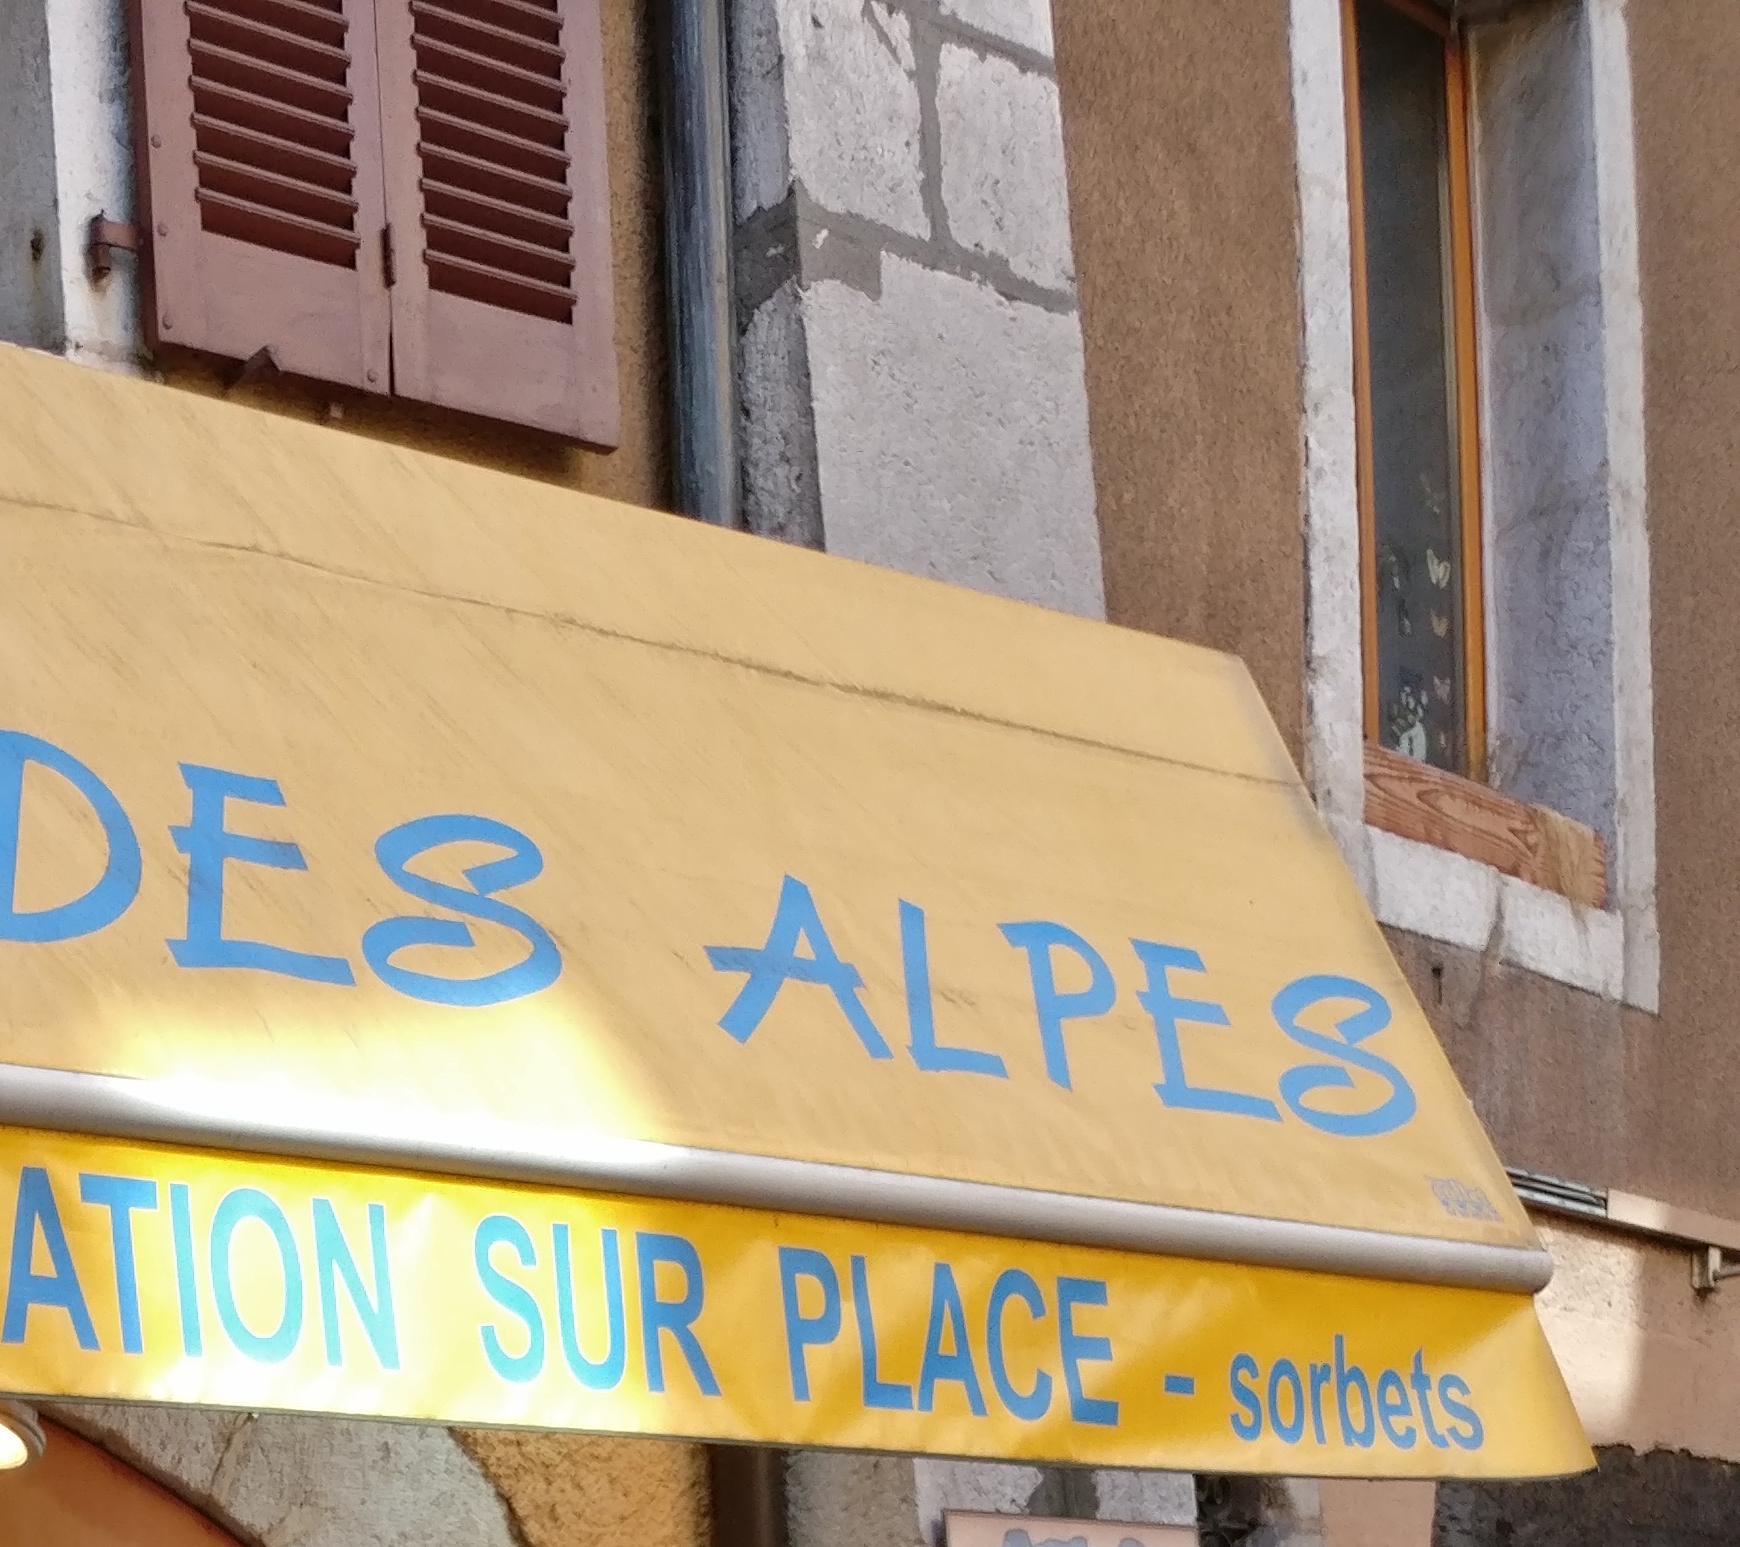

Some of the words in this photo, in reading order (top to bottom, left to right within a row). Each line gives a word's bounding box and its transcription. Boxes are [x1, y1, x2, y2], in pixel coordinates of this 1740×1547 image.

[706, 875, 1415, 1137] ALPES
[473, 1215, 724, 1398] SUR
[780, 1247, 1119, 1427] PLACE
[1228, 1333, 1484, 1451] sorbets
